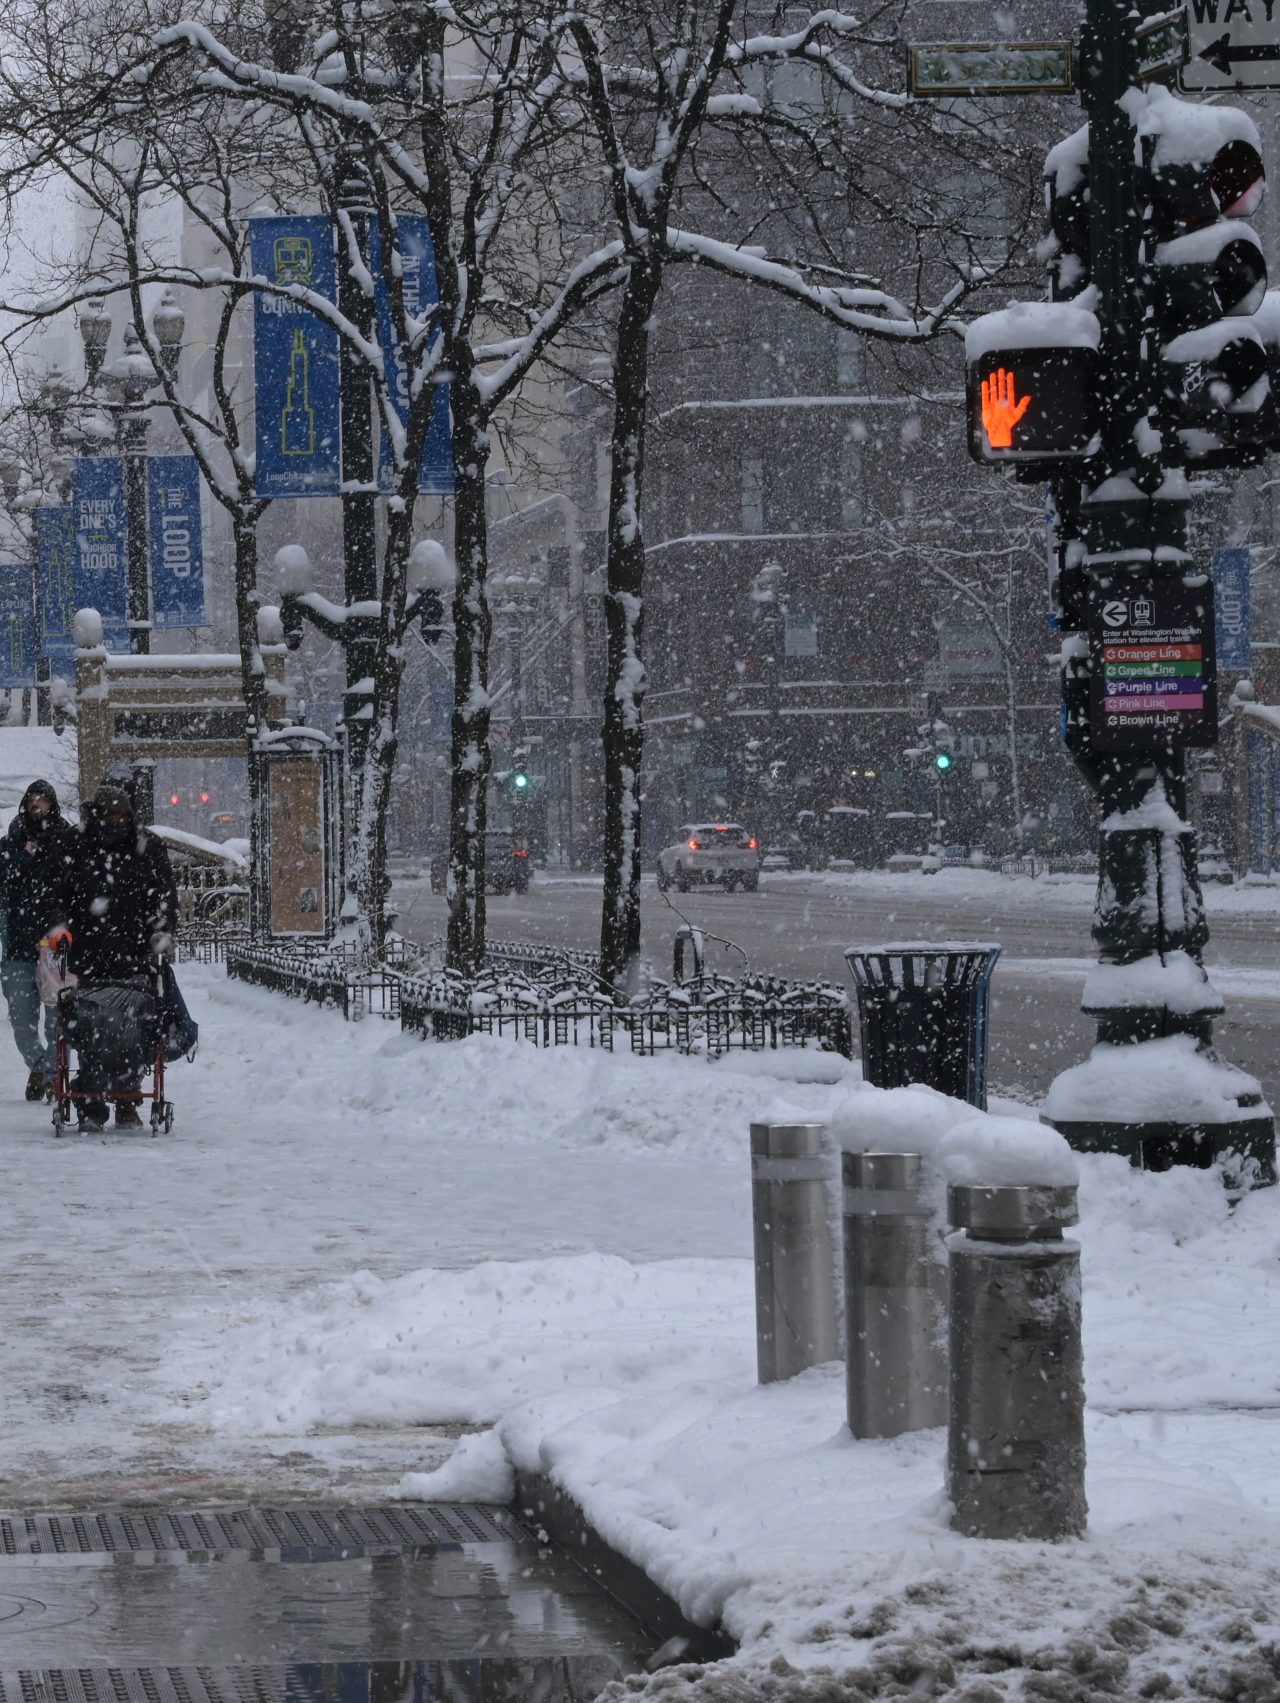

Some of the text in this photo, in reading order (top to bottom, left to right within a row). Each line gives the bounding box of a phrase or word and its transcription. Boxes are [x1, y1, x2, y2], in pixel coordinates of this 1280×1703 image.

[167, 487, 182, 509] THE
[80, 499, 116, 514] EVERY
[80, 514, 117, 530] ONE'S
[162, 515, 191, 578] LOOP
[81, 553, 118, 569] HOOD
[1222, 591, 1242, 635] LOOP
[1140, 635, 1168, 643] elevated
[1117, 647, 1181, 660] Orange Line
[1118, 665, 1175, 676] Green Line
[1118, 680, 1178, 693] Purple Line
[1119, 698, 1166, 709] Pink Line
[1119, 714, 1179, 725] Brown Line
